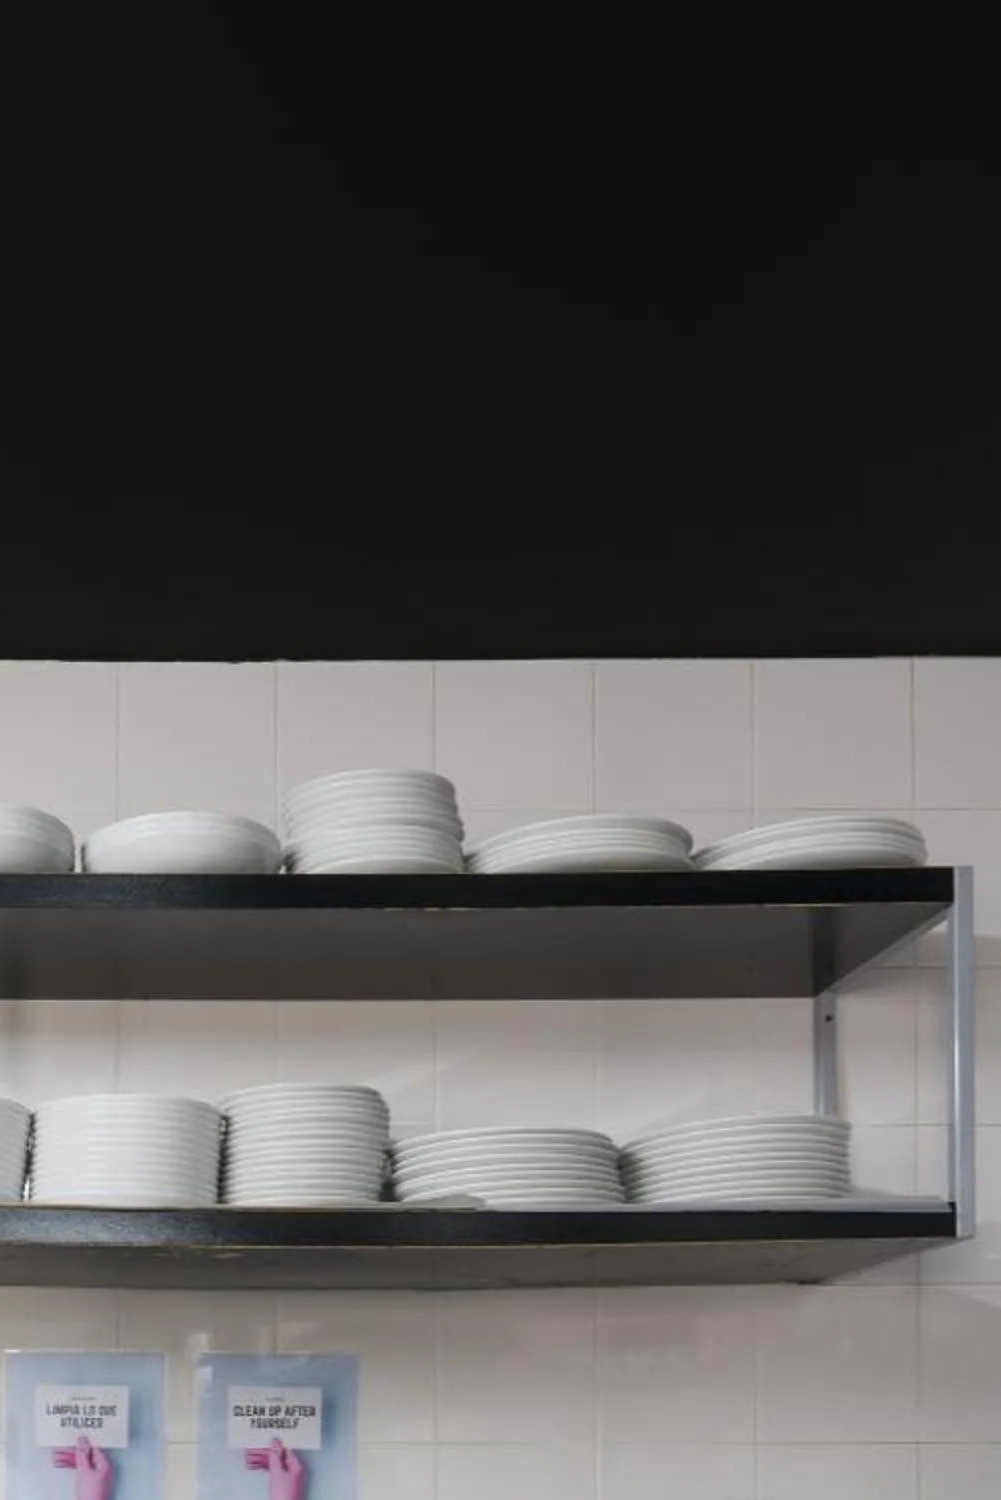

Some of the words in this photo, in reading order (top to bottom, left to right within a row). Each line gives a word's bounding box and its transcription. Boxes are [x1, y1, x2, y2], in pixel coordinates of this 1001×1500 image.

[233, 1405, 266, 1417] CLEAN
[268, 1405, 281, 1417] UP
[285, 1405, 316, 1417] AFTER
[250, 1418, 299, 1429] YOURSELF
